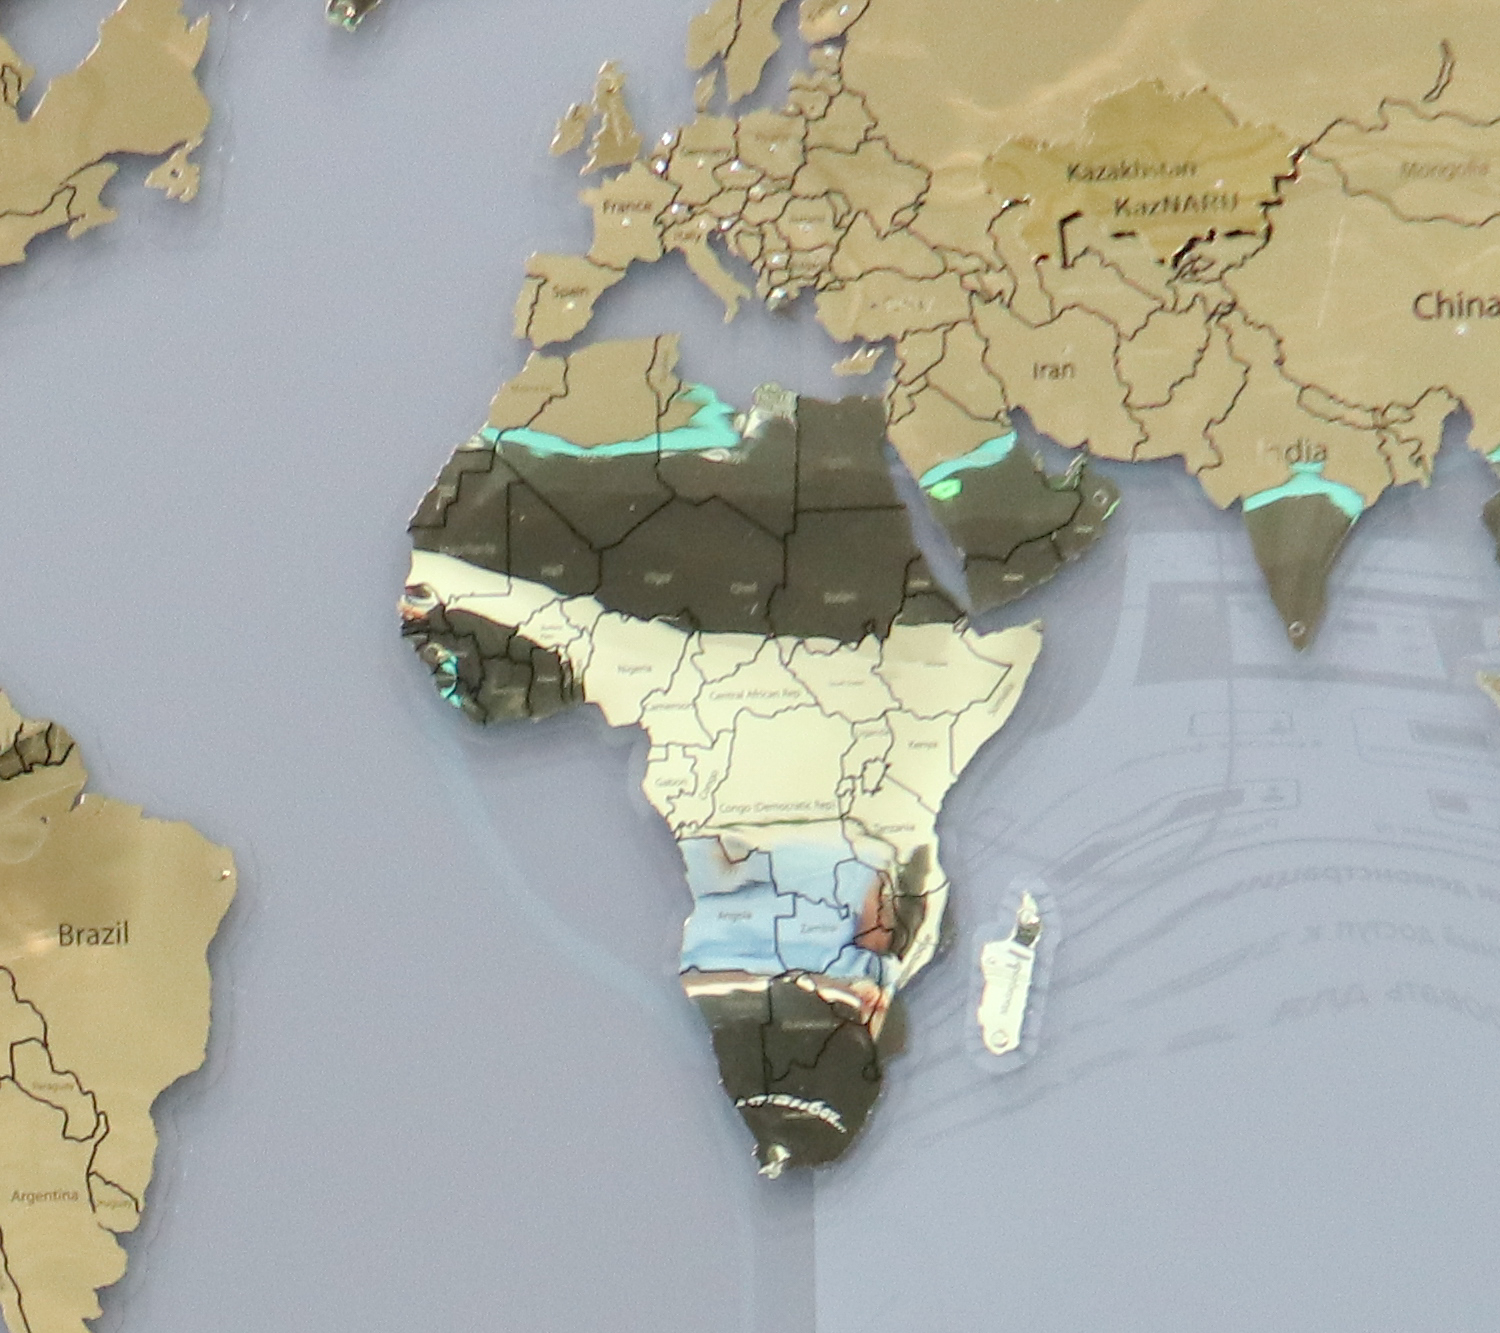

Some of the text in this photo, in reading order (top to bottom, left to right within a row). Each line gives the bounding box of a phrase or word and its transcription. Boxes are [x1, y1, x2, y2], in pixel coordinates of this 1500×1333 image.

[1067, 160, 1198, 182] Kazakhstan
[1401, 160, 1489, 181] Mongolia
[604, 200, 652, 214] France
[1114, 193, 1238, 217] KazNARU
[553, 285, 589, 298] Spain
[1033, 362, 1075, 380] Iran
[1257, 438, 1327, 464] India
[59, 921, 129, 947] Brazil
[11, 1190, 79, 1205] Argentina
